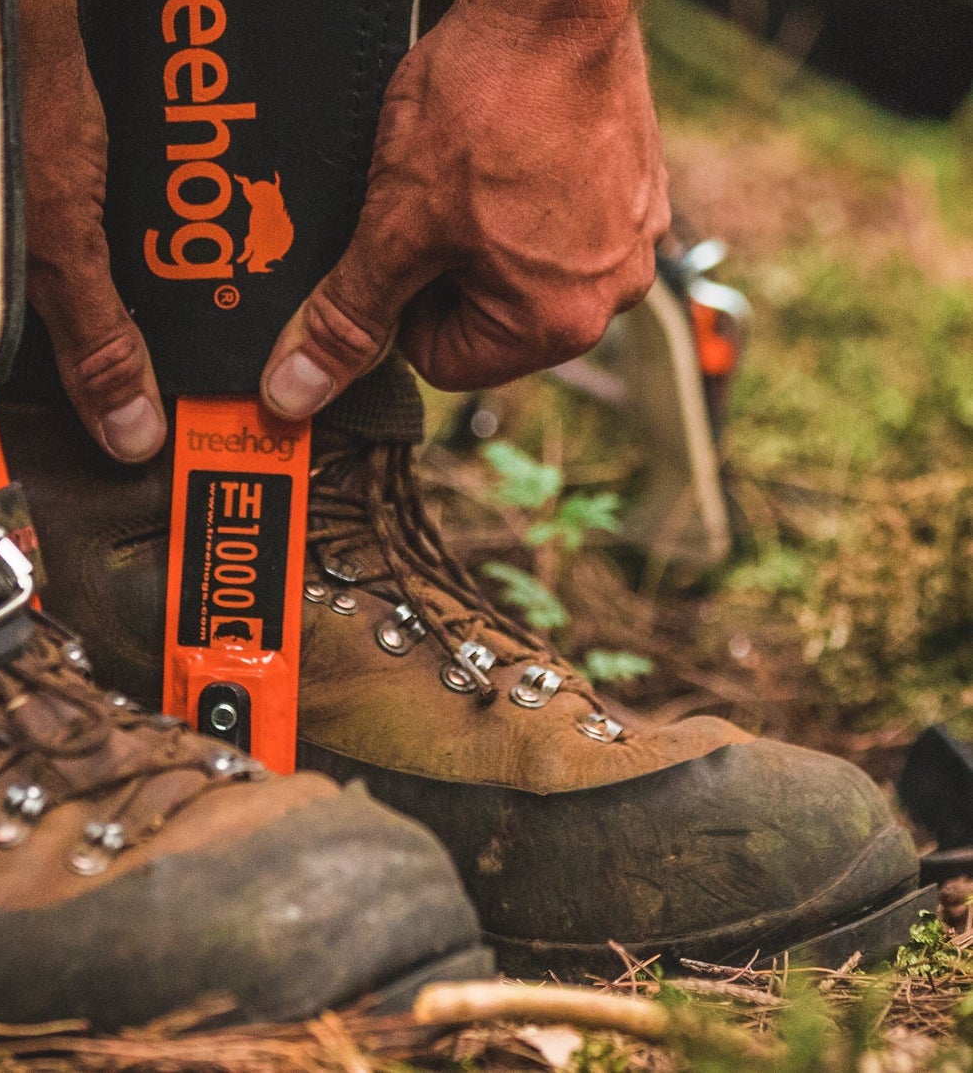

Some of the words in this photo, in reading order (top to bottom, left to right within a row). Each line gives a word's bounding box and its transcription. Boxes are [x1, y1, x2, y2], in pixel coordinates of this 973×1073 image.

[187, 427, 296, 462] treehog
[220, 481, 263, 520] TH
[212, 523, 260, 609] 1000
